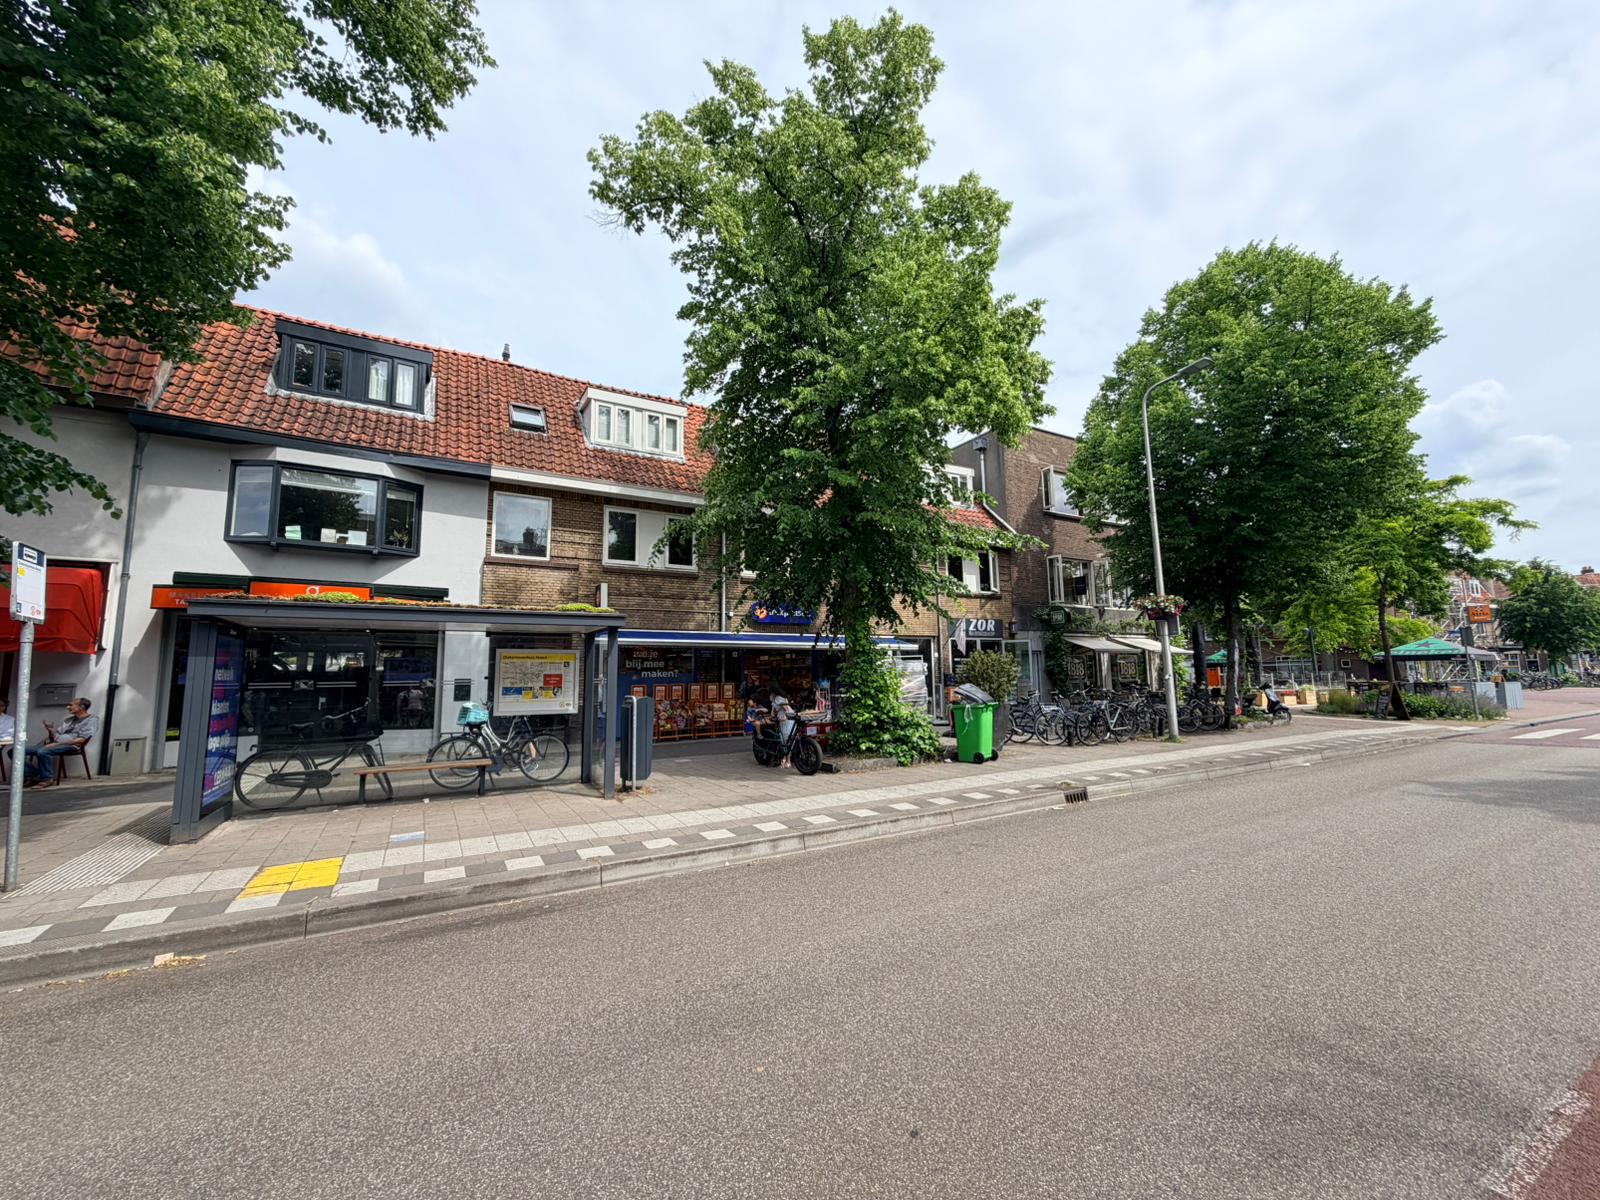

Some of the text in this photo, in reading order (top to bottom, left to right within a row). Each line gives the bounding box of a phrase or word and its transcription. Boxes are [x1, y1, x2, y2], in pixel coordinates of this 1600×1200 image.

[969, 619, 995, 631] ZOR
[625, 660, 641, 669] blij
[1120, 662, 1136, 675] 1818
[641, 669, 679, 678] maken?
